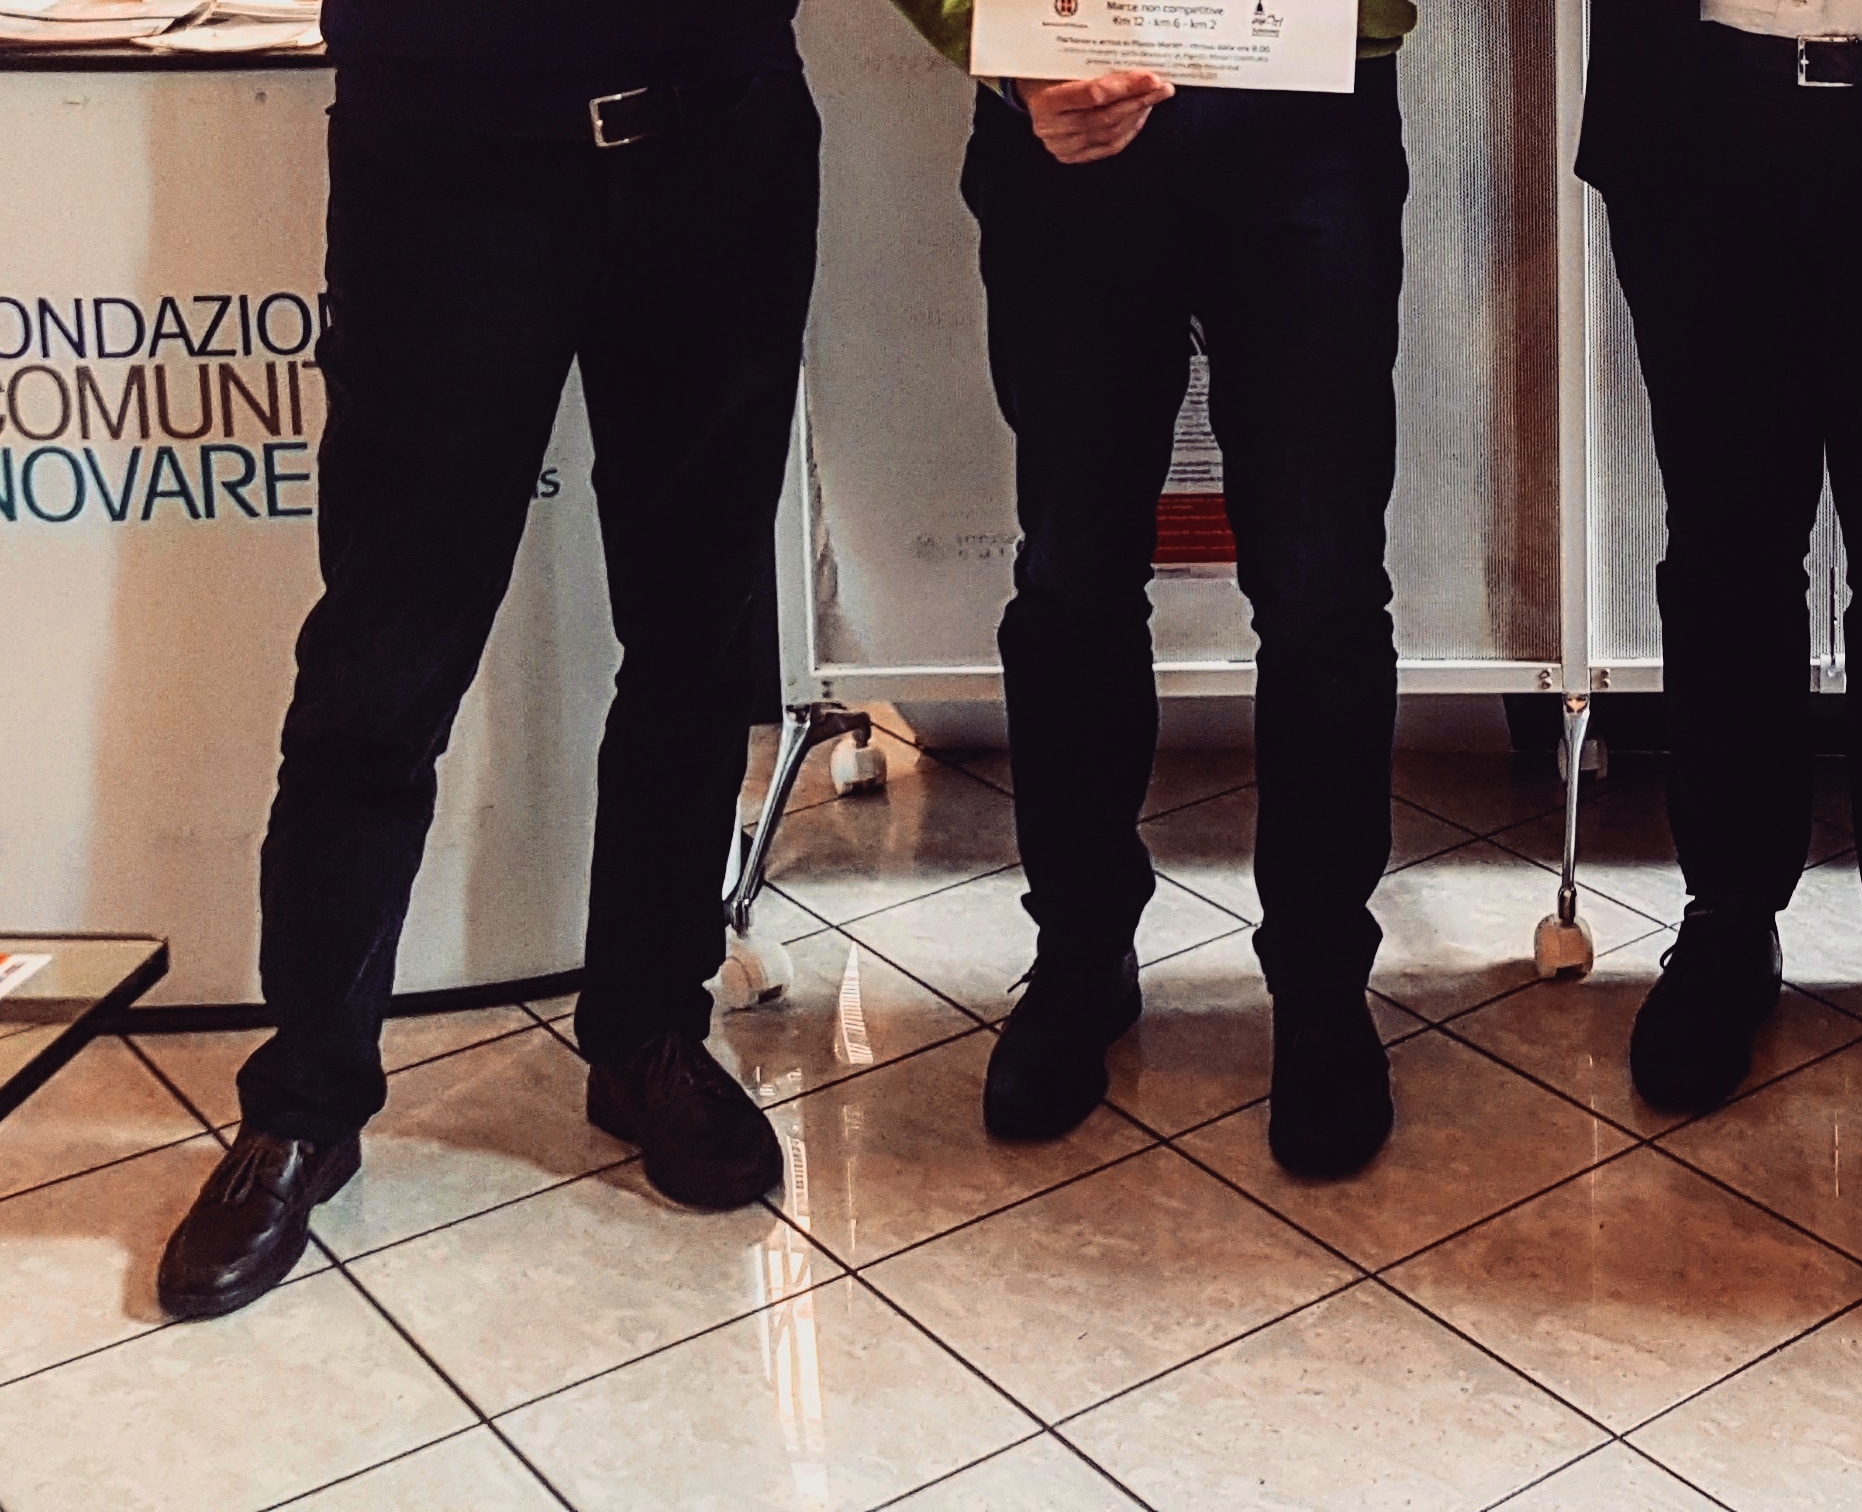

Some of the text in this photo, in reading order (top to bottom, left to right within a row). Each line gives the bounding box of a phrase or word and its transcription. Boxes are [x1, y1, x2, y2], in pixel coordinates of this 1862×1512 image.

[1209, 19, 1217, 31] 2
[0, 292, 332, 359] ONDAZIO
[0, 360, 319, 440] OMUNI
